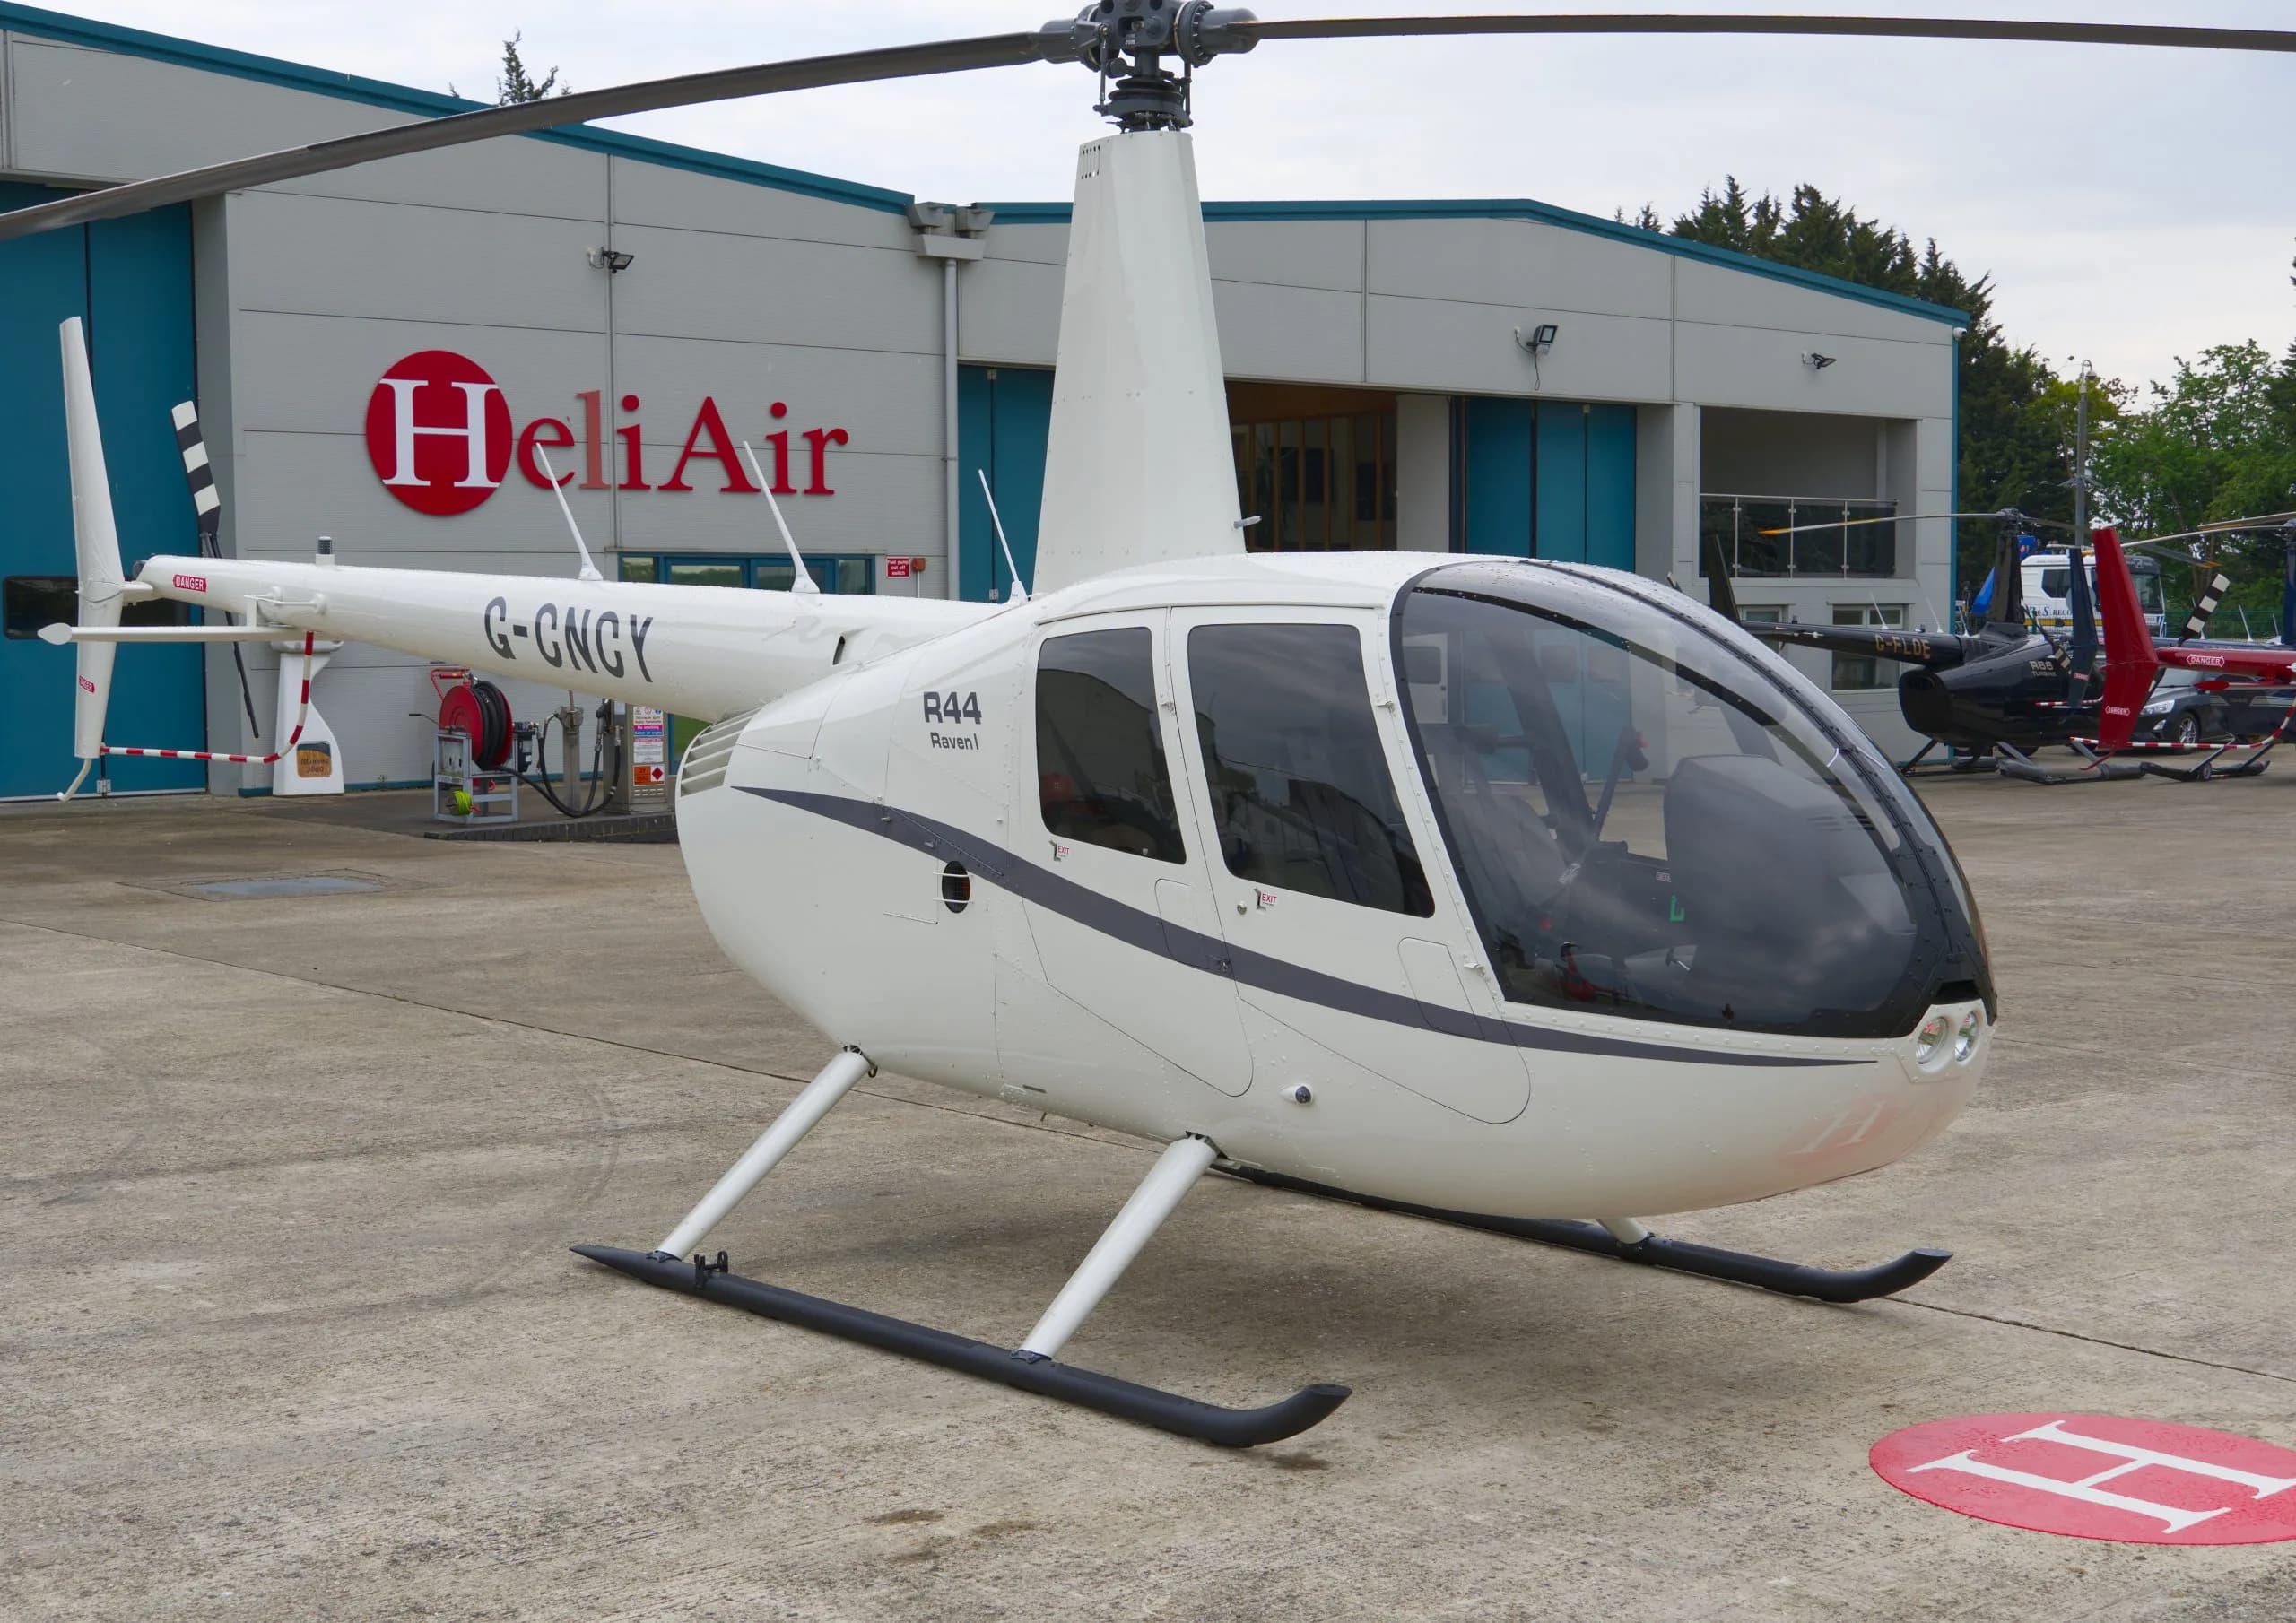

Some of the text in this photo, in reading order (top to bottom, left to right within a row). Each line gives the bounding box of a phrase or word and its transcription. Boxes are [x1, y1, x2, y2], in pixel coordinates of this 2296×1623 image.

[378, 378, 849, 496] HeliAir
[175, 576, 204, 591] DANGER
[484, 596, 653, 682] G-CNCY
[2190, 656, 2221, 664] DANGER
[924, 691, 982, 725] R44
[930, 732, 973, 750] Raven
[1057, 846, 1070, 855] EXIT
[1262, 893, 1278, 904] EXIT
[1906, 1419, 2296, 1534] H
